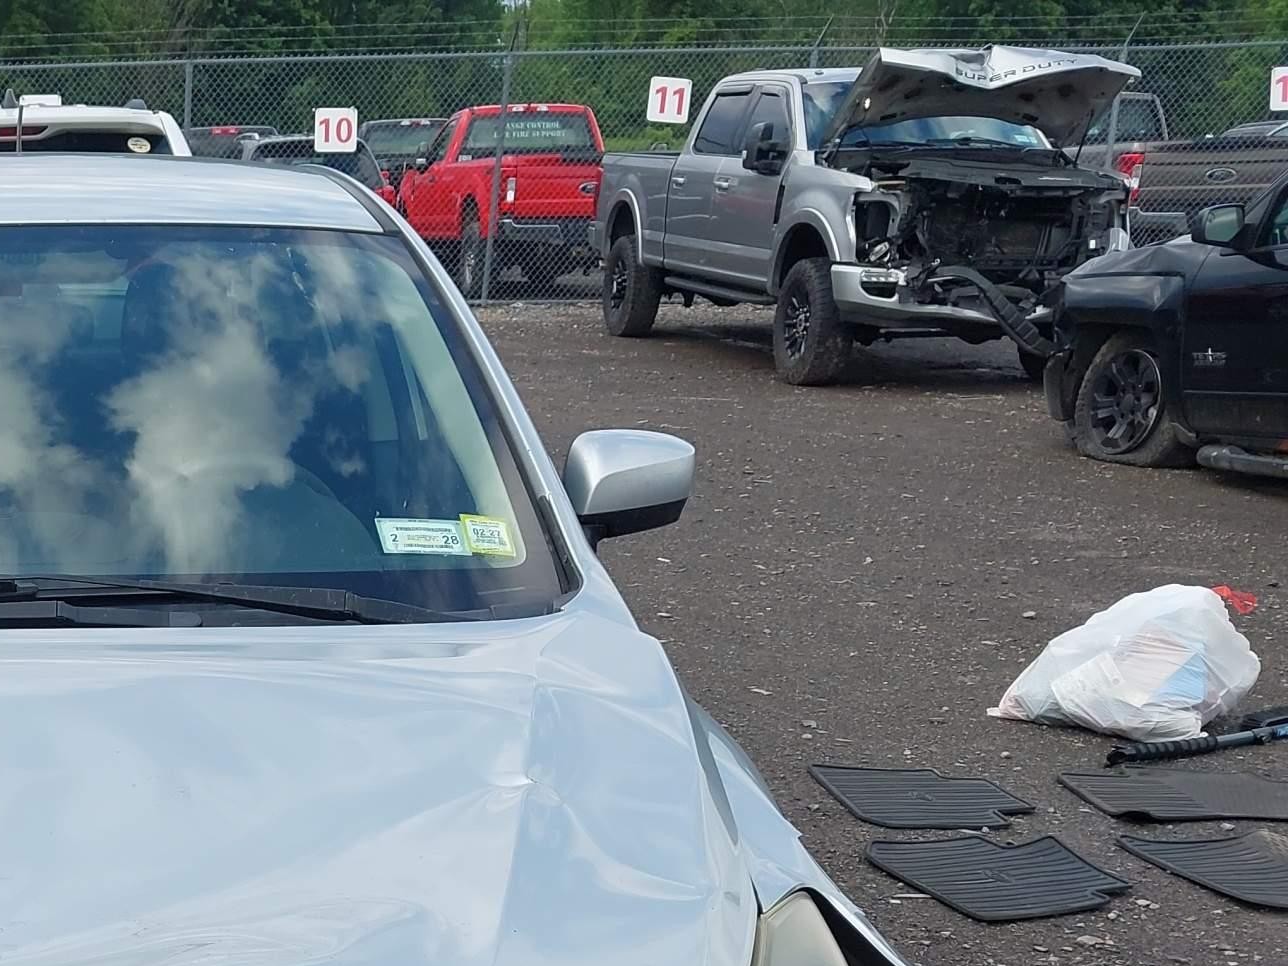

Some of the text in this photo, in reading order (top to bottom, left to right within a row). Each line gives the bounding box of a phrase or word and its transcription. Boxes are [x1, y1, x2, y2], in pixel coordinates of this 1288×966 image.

[955, 58, 1078, 83] SUPER DUTY
[655, 86, 685, 115] 11
[318, 117, 353, 143] 10
[512, 130, 529, 138] FIRE
[526, 121, 561, 129] CONTROL
[389, 533, 399, 543] 2
[442, 535, 460, 545] 28
